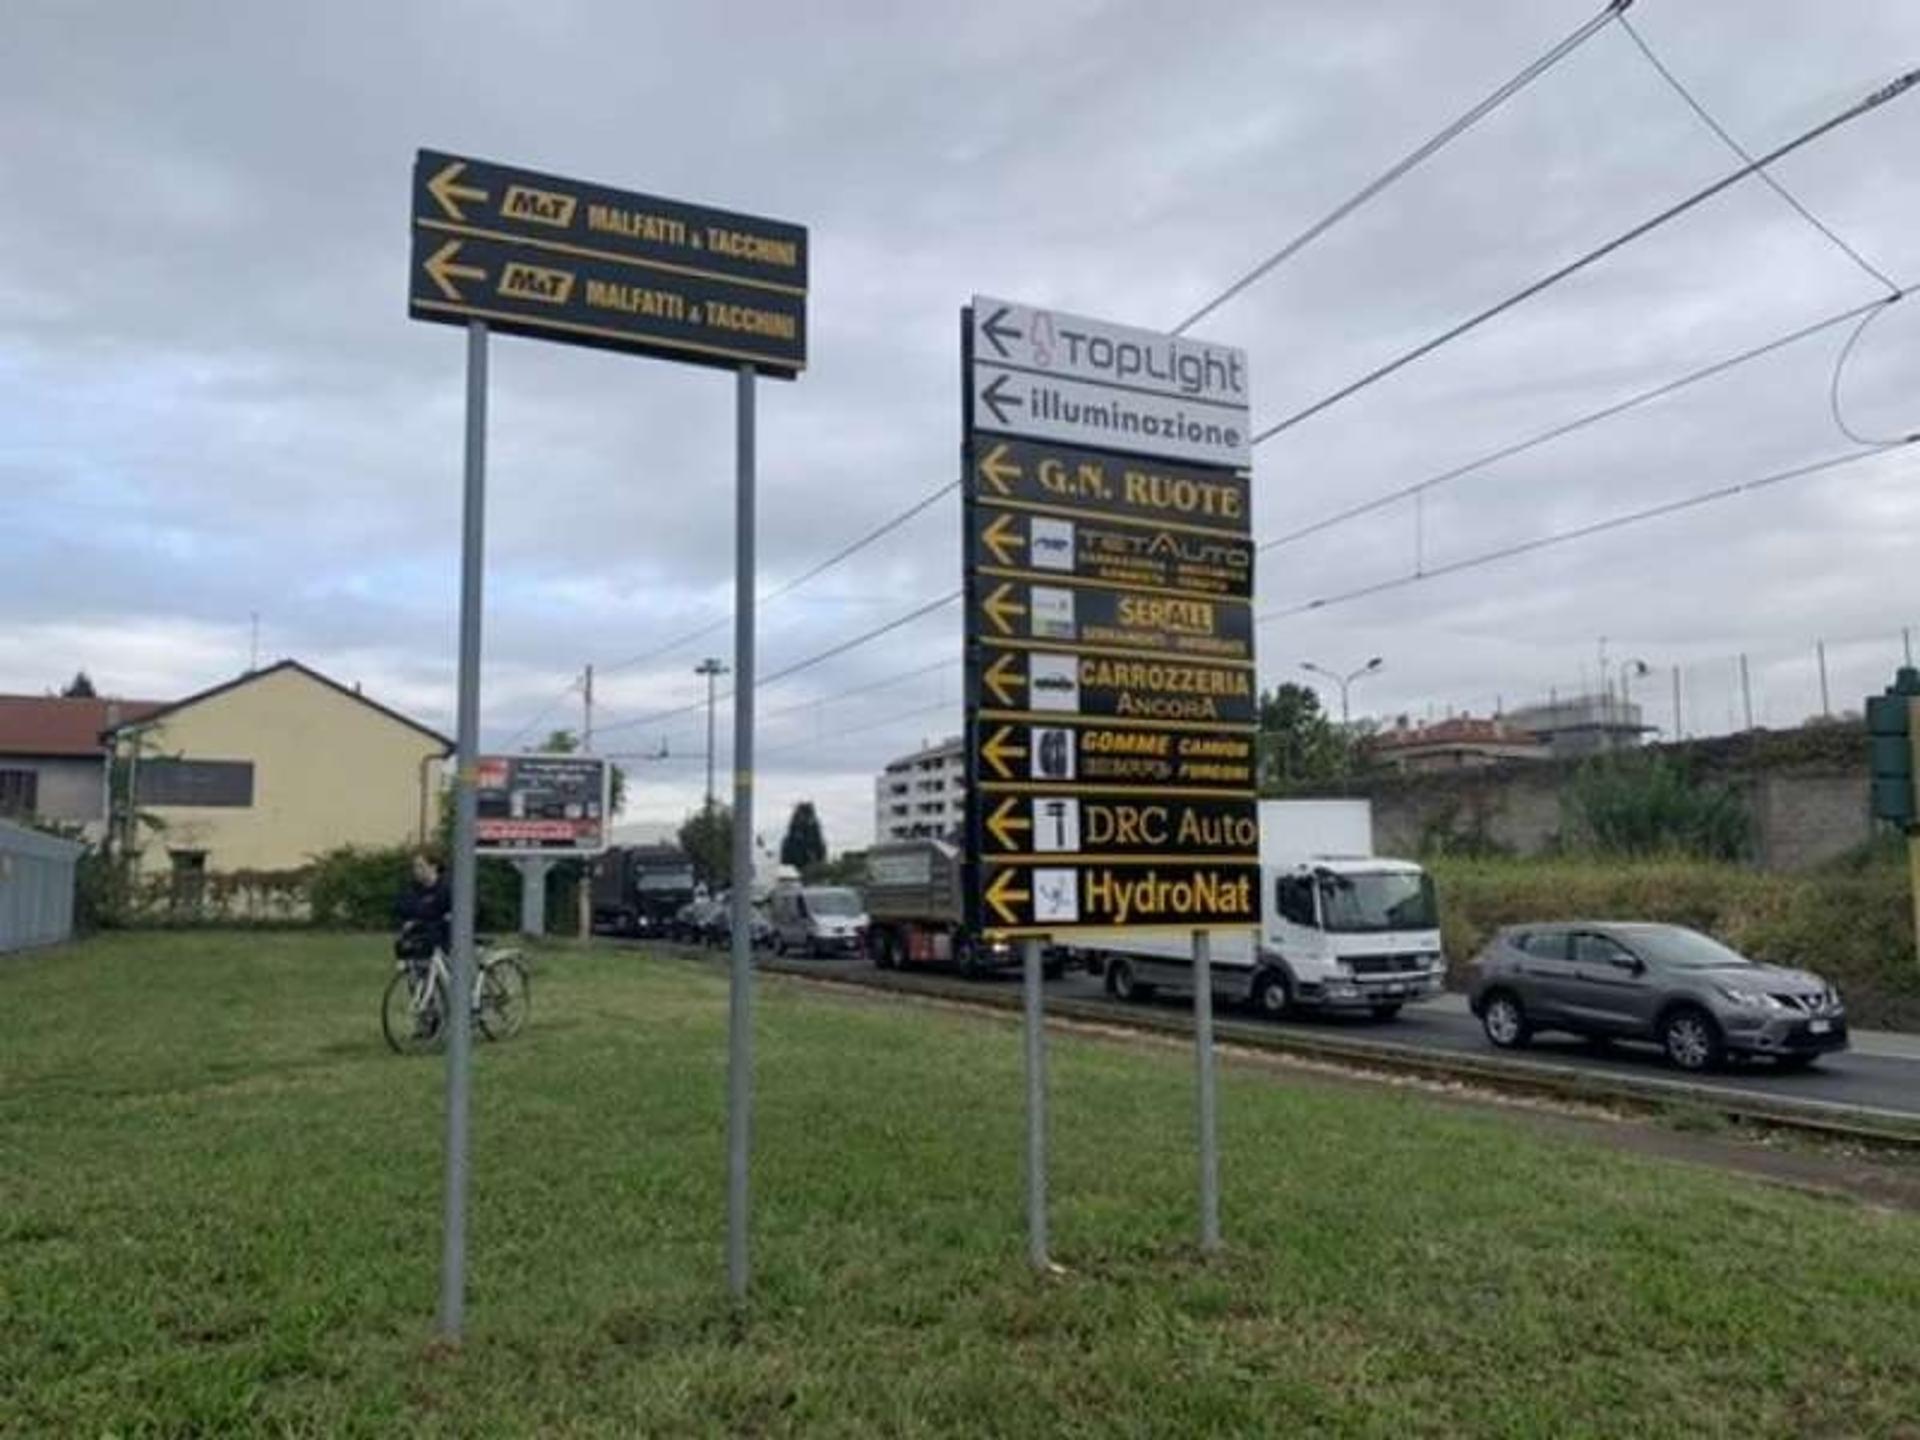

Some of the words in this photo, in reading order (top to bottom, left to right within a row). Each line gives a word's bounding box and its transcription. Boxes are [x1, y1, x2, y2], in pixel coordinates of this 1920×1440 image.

[508, 189, 569, 222] M&T
[588, 204, 686, 246] MALFATTI
[707, 227, 796, 267] TACCHINI
[505, 266, 566, 299] M&T
[586, 278, 684, 320] MALFATTI
[705, 301, 795, 339] TACCHINI
[1031, 387, 1241, 448] illuminazione
[1039, 459, 1112, 499] G.N.
[1125, 470, 1243, 519] RUOTE
[1080, 660, 1249, 695] CARROZZERIA
[1081, 731, 1171, 755] GOMME
[1086, 805, 1169, 845] DRC
[1176, 806, 1258, 846] Auto
[1086, 870, 1250, 922] HydroNat
